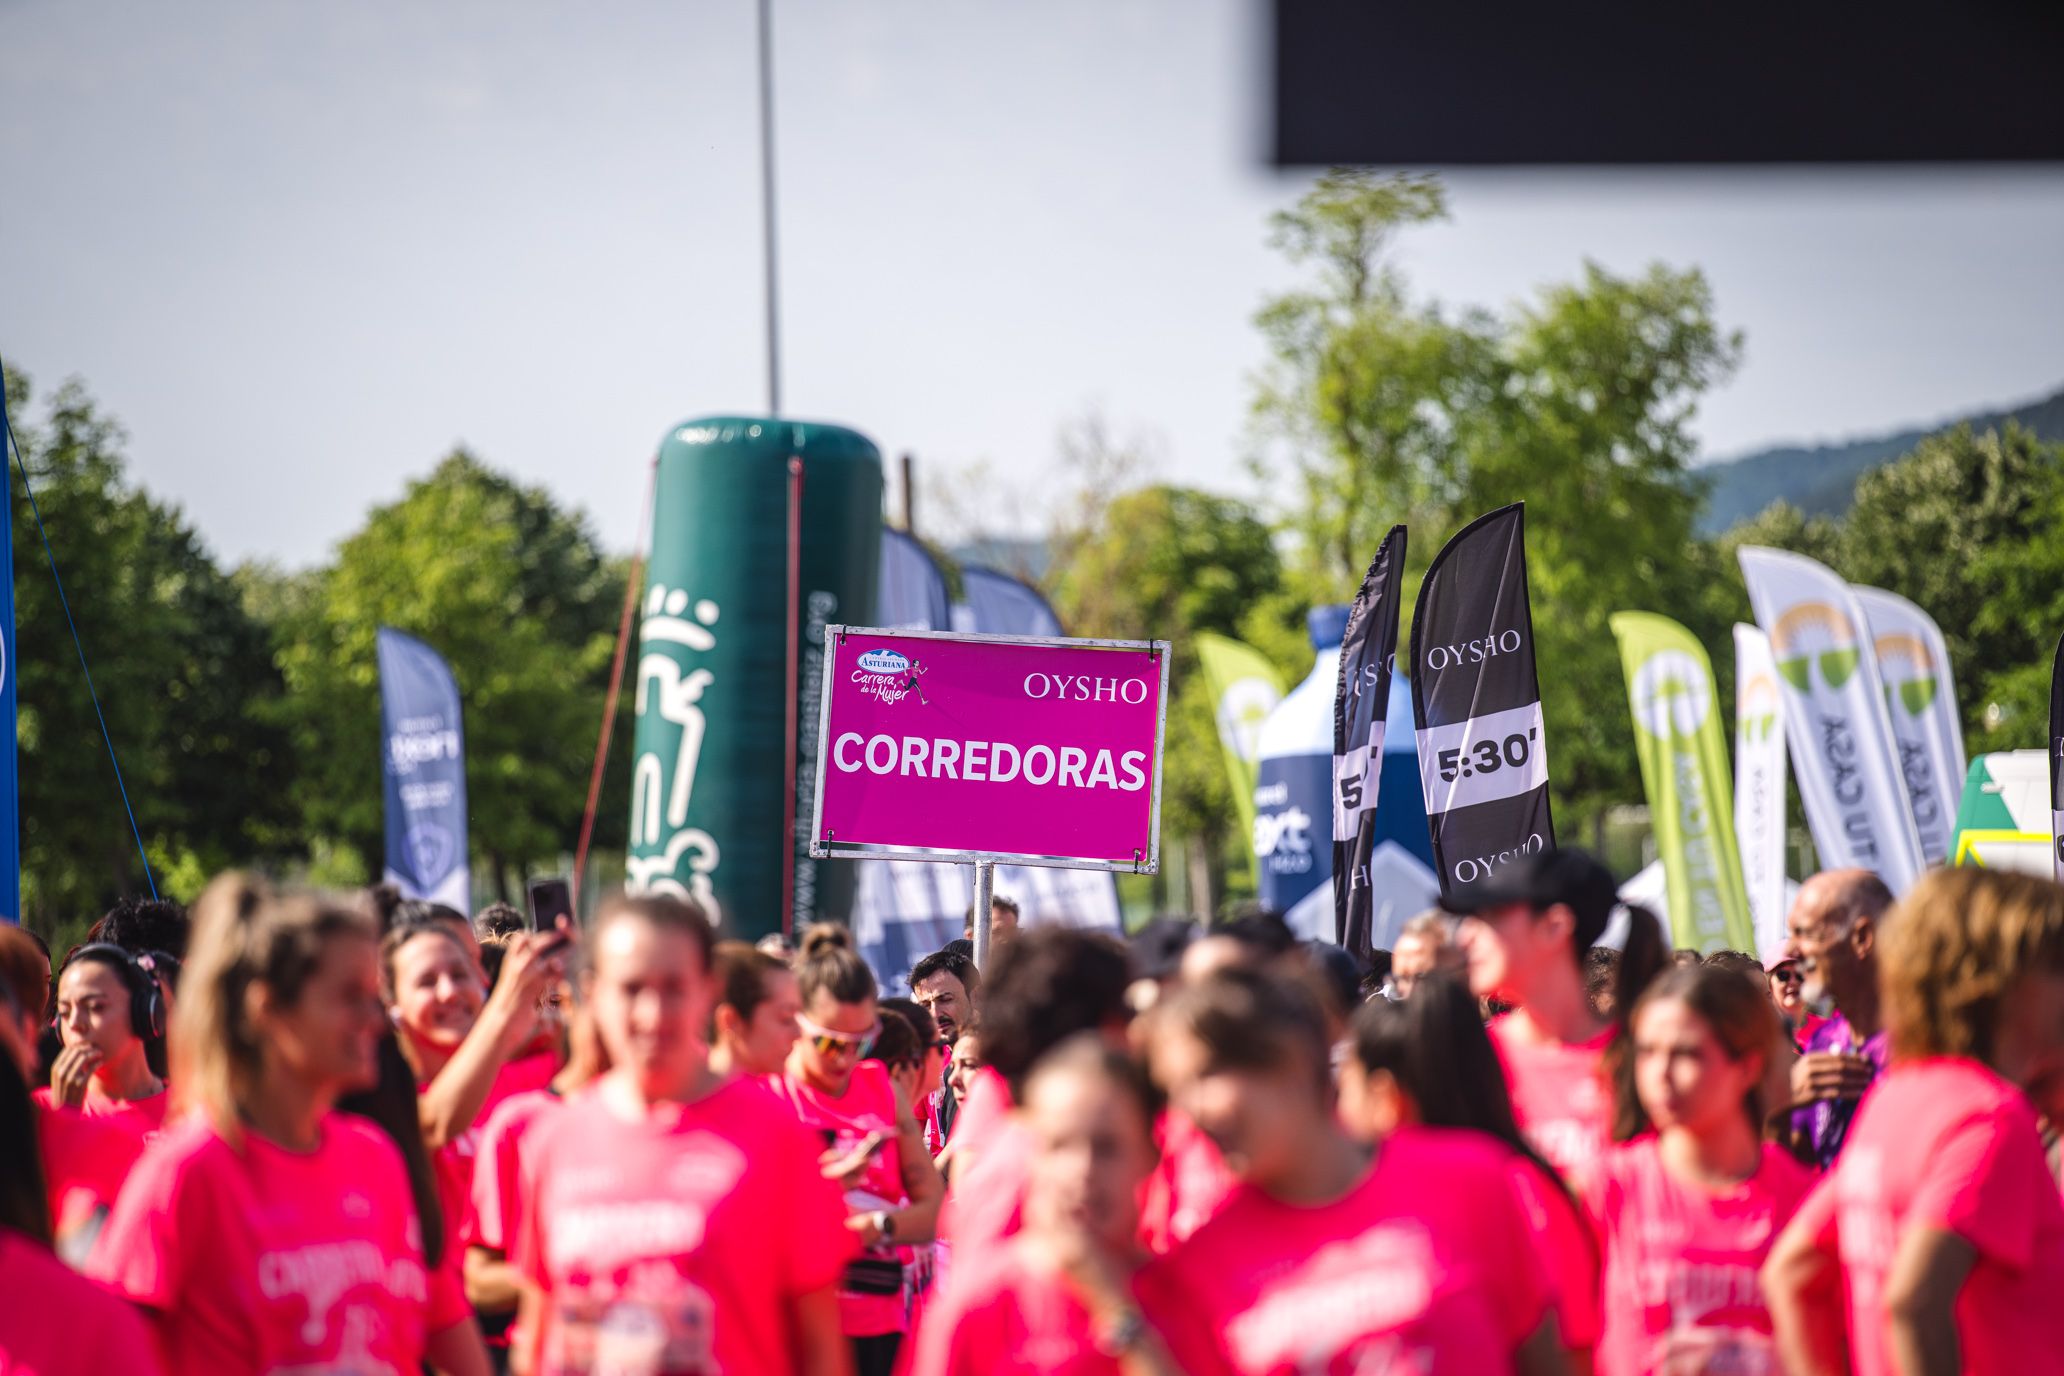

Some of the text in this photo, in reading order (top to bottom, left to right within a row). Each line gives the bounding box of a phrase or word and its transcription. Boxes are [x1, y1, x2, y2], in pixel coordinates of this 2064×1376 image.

[862, 657, 905, 668] ASTURIANA
[1427, 629, 1521, 670] OYSHO
[851, 670, 895, 685] Carrera
[1023, 672, 1148, 704] OYSHO
[860, 684, 909, 705] de la Mujer
[833, 732, 1146, 792] CORREDORAS
[1438, 727, 1537, 783] 5:30'
